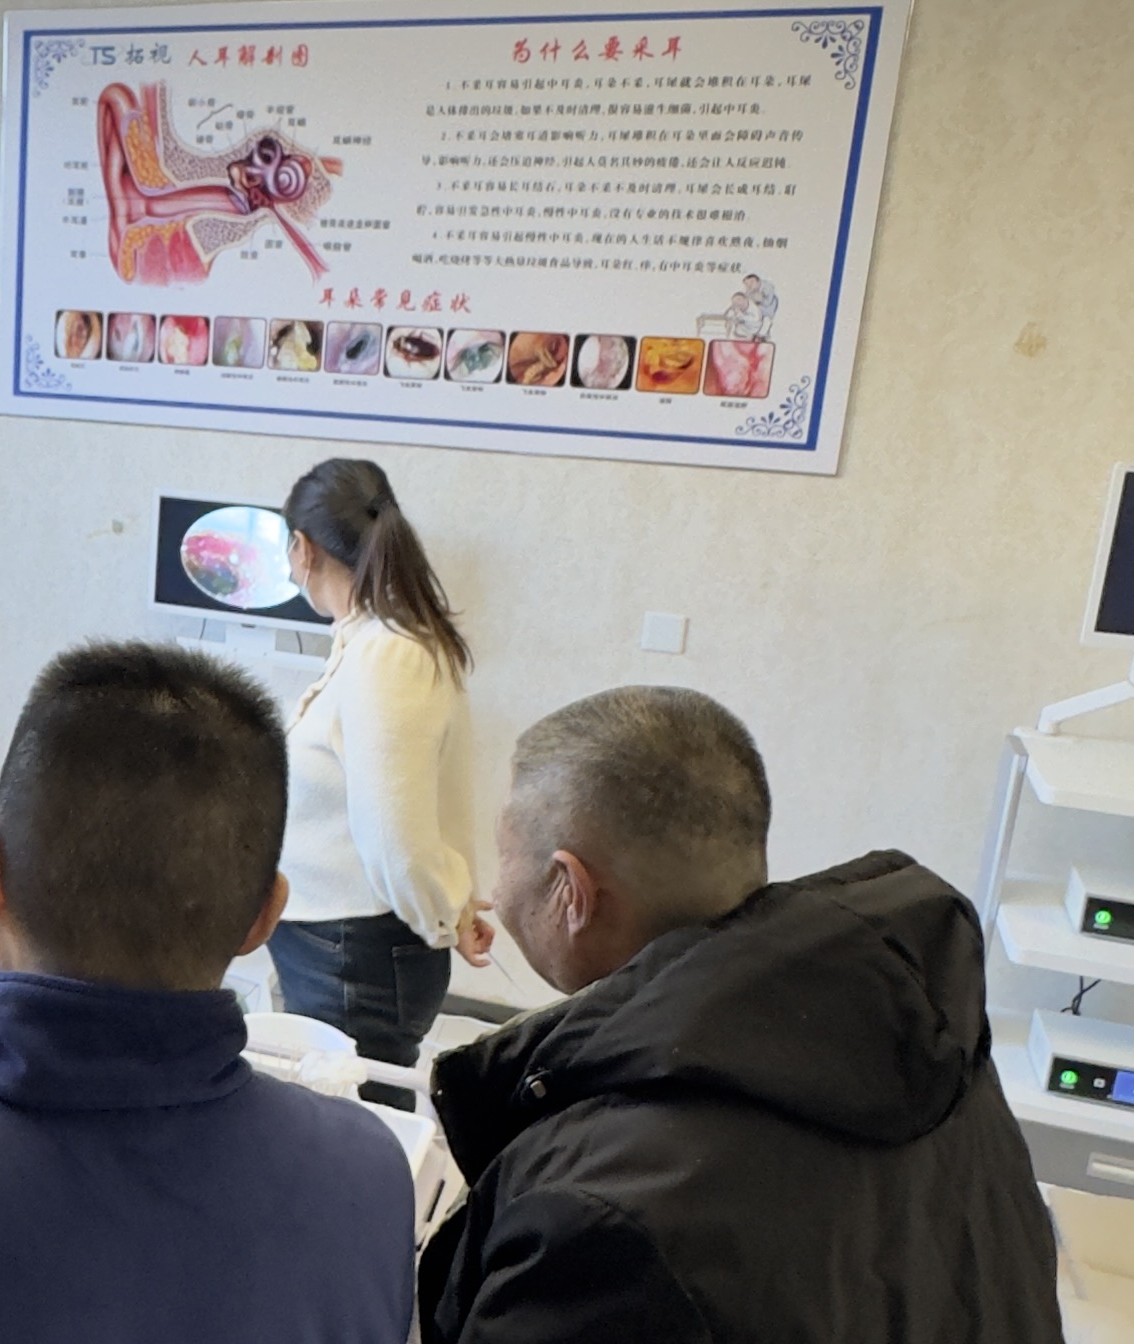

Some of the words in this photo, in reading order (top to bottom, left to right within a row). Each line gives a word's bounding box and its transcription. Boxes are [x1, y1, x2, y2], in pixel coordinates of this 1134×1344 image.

[89, 46, 117, 66] TS
[124, 42, 172, 66] 拓视
[187, 42, 310, 68] 人耳解剖图
[512, 35, 682, 64] 为什么要采耳
[318, 287, 473, 315] 耳朵常见症状
